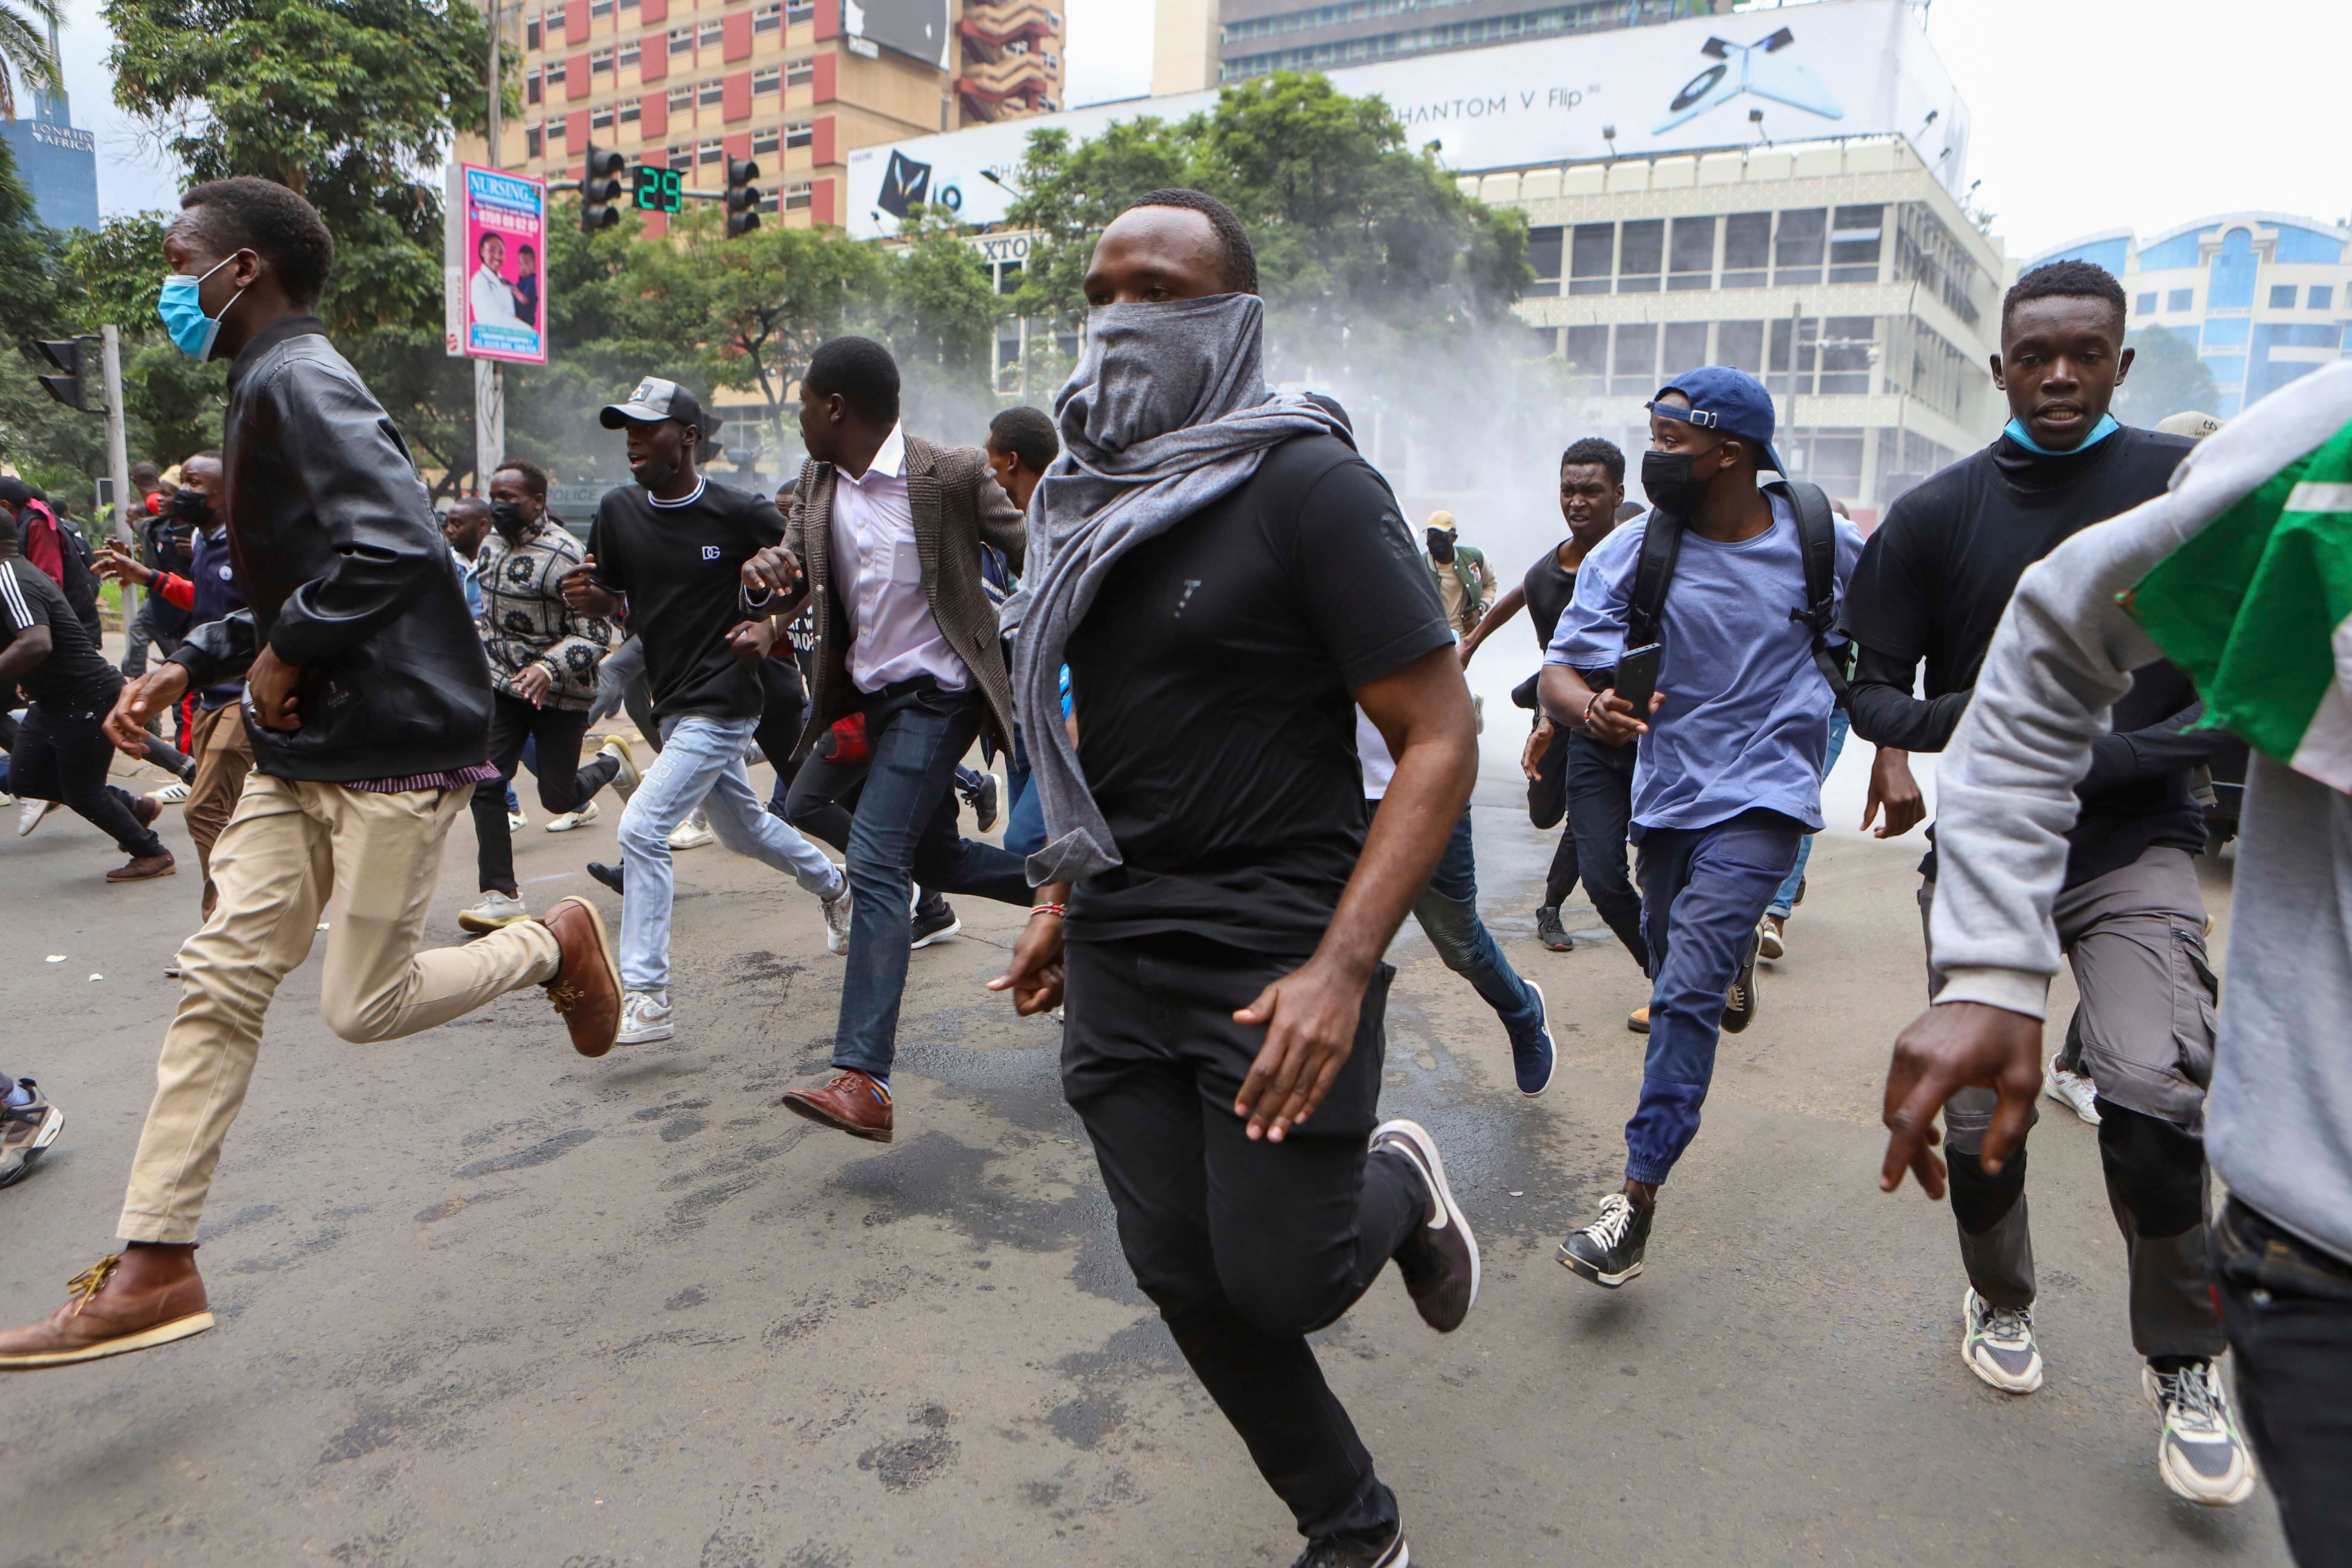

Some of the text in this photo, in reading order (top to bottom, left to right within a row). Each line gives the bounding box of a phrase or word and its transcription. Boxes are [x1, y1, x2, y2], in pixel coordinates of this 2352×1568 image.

[1521, 90, 1536, 108] V
[1549, 87, 1582, 111] Flip
[44, 134, 94, 152] AFRICA
[639, 167, 681, 212] 29
[548, 488, 598, 501] POLICE
[702, 546, 720, 561] DG
